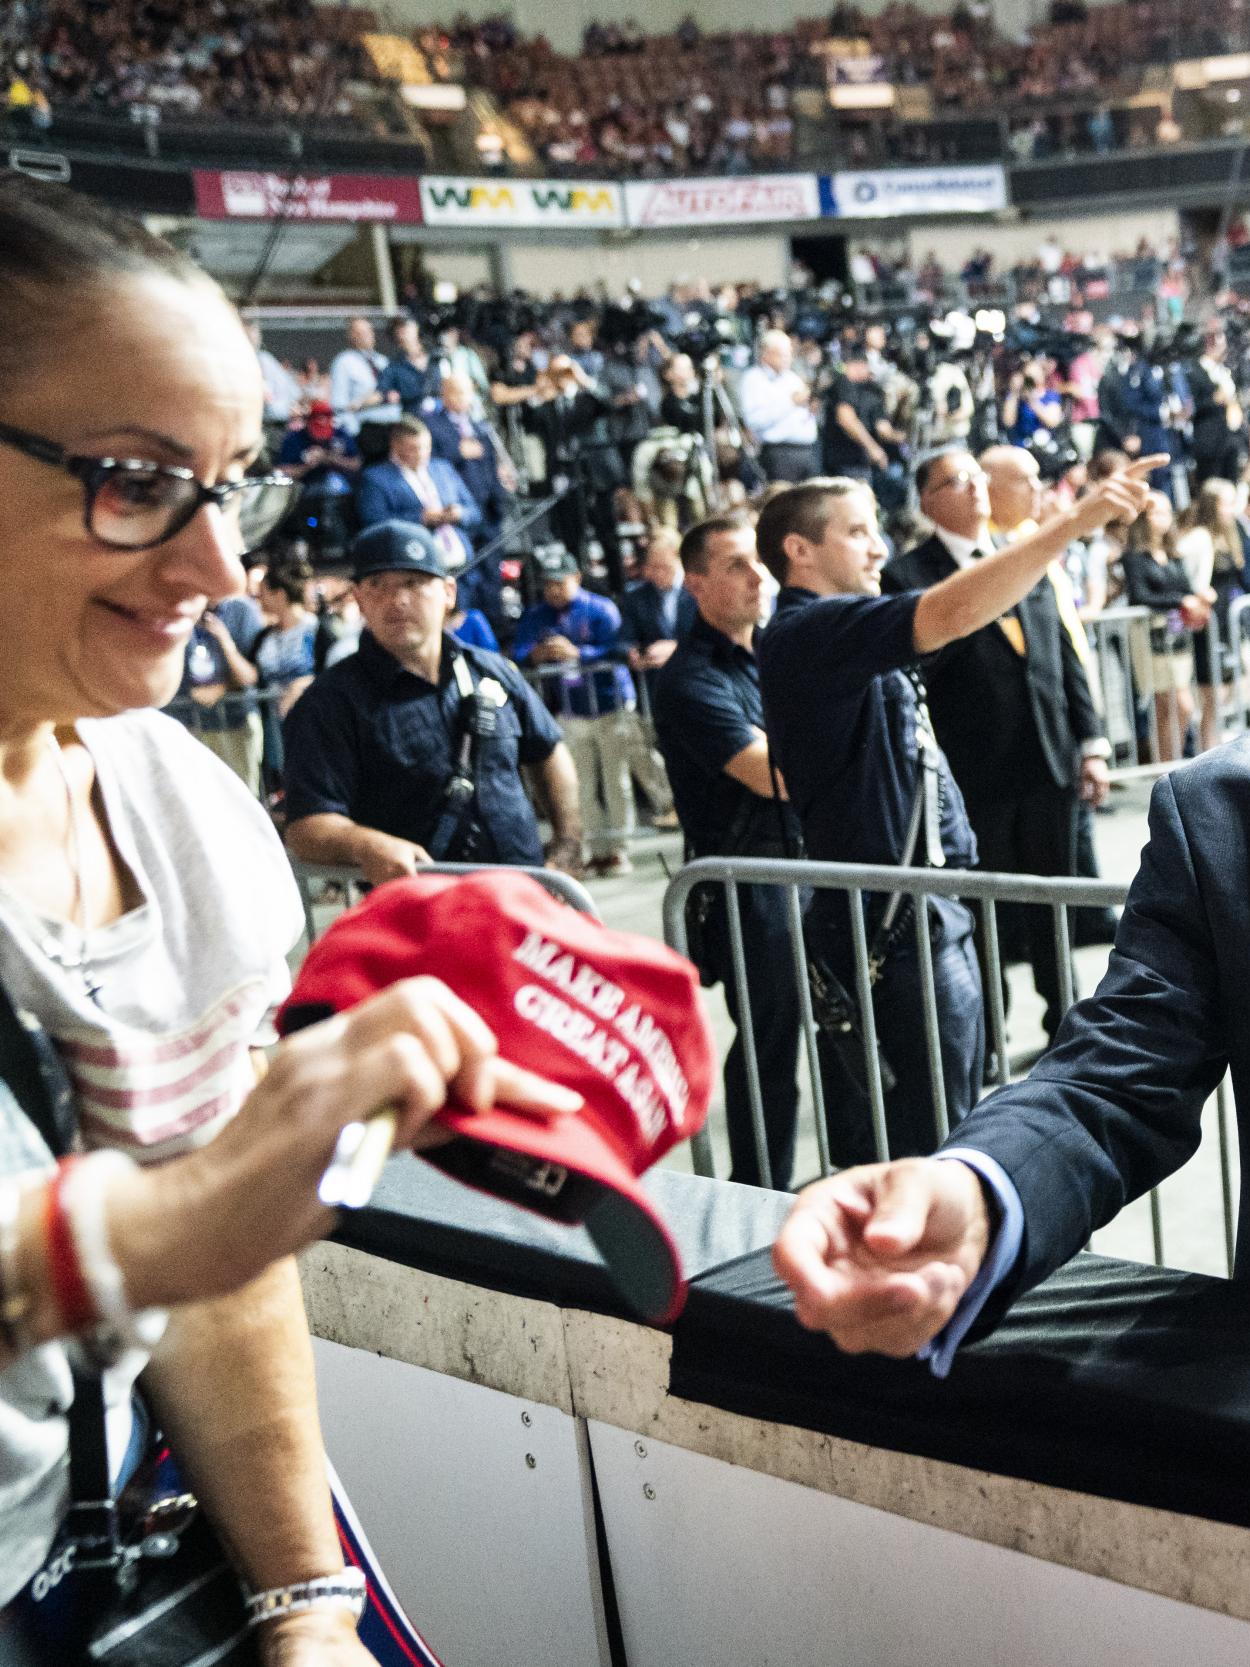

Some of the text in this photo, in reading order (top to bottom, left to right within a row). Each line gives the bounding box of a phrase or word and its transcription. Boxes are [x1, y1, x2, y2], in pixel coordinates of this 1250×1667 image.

[429, 186, 515, 209] WM
[532, 189, 613, 214] WM
[512, 930, 626, 1021] MAKE
[513, 983, 631, 1080] GREAT
